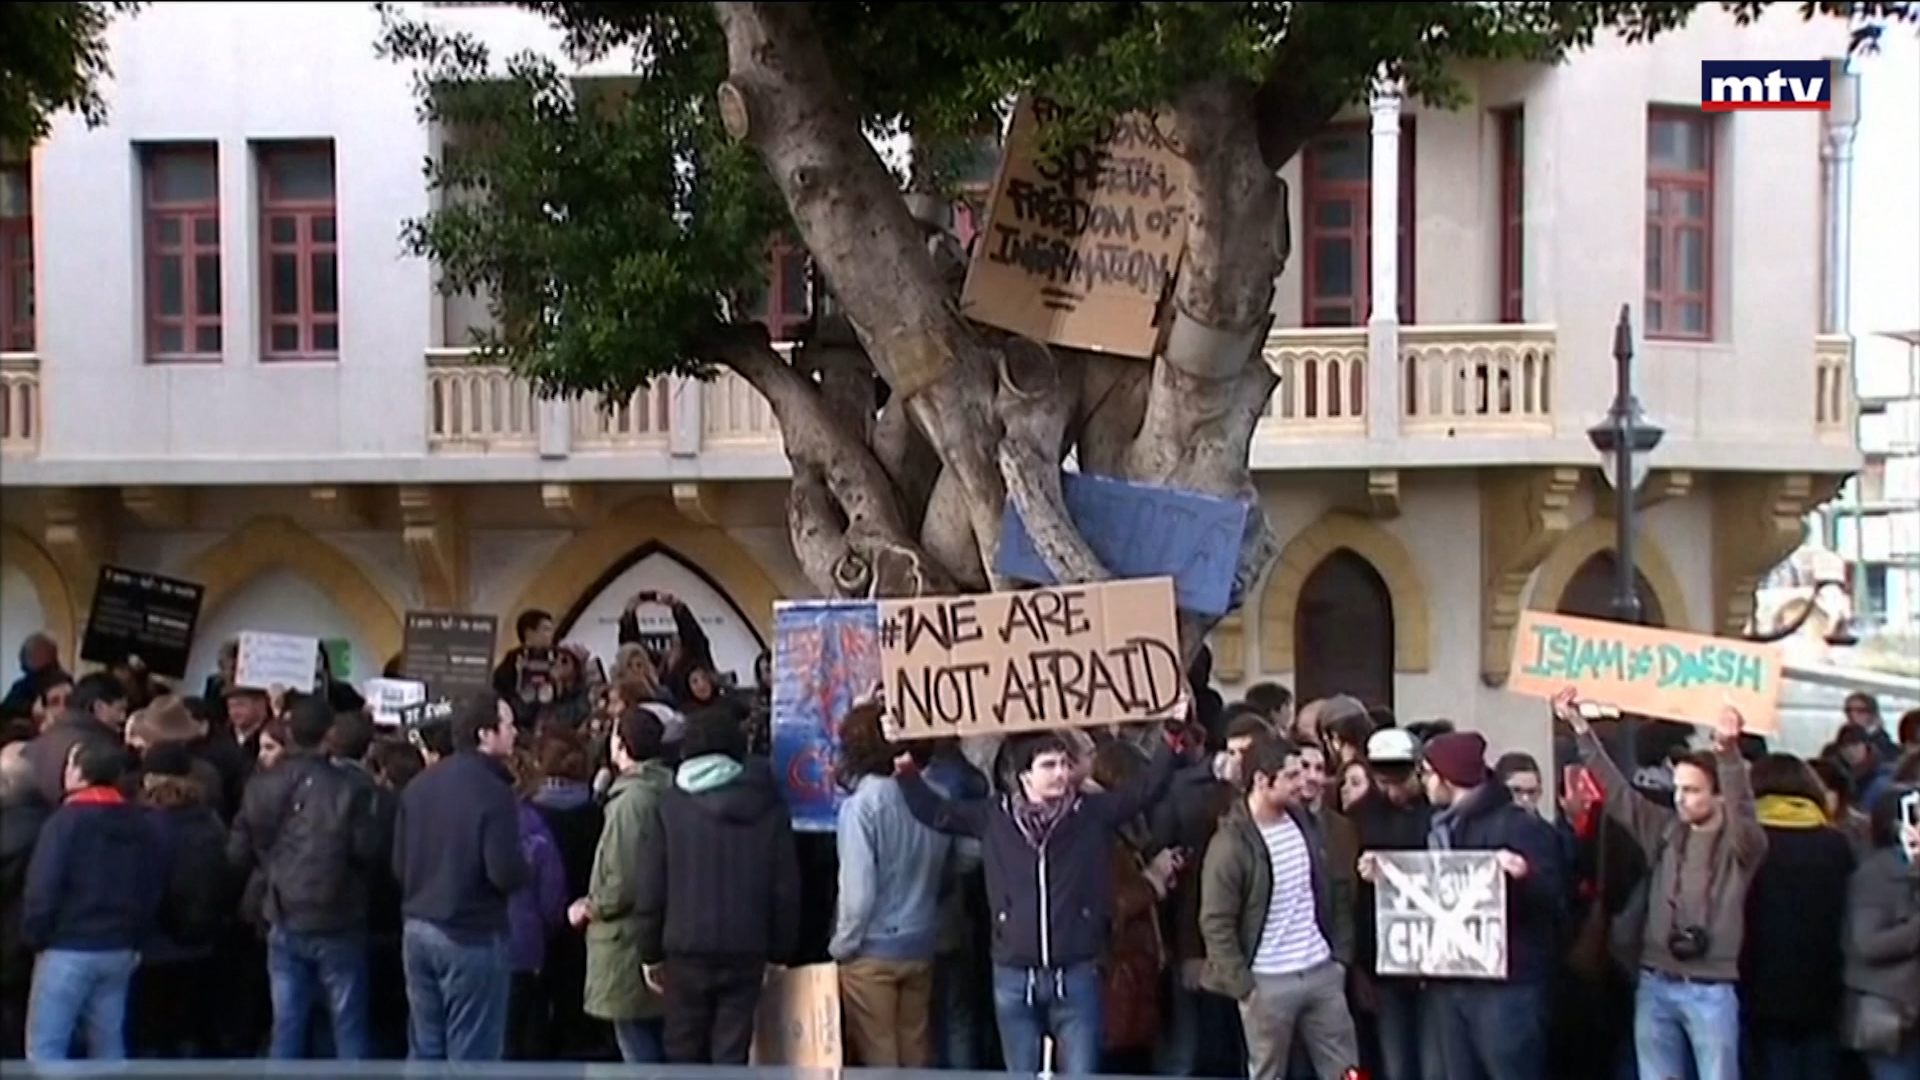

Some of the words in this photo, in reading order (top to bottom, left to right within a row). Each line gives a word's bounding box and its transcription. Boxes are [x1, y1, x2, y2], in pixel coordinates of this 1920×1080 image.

[1006, 179, 1139, 242] FREEDOM
[1145, 205, 1184, 240] OF
[990, 223, 1168, 294] INFORMATION
[881, 600, 983, 654] #WE
[998, 591, 1089, 643] ARE
[892, 662, 989, 728] NOT
[992, 637, 1182, 723] AFRAID
[1522, 624, 1624, 681] ISLAM
[1656, 644, 1762, 691] DAESH
